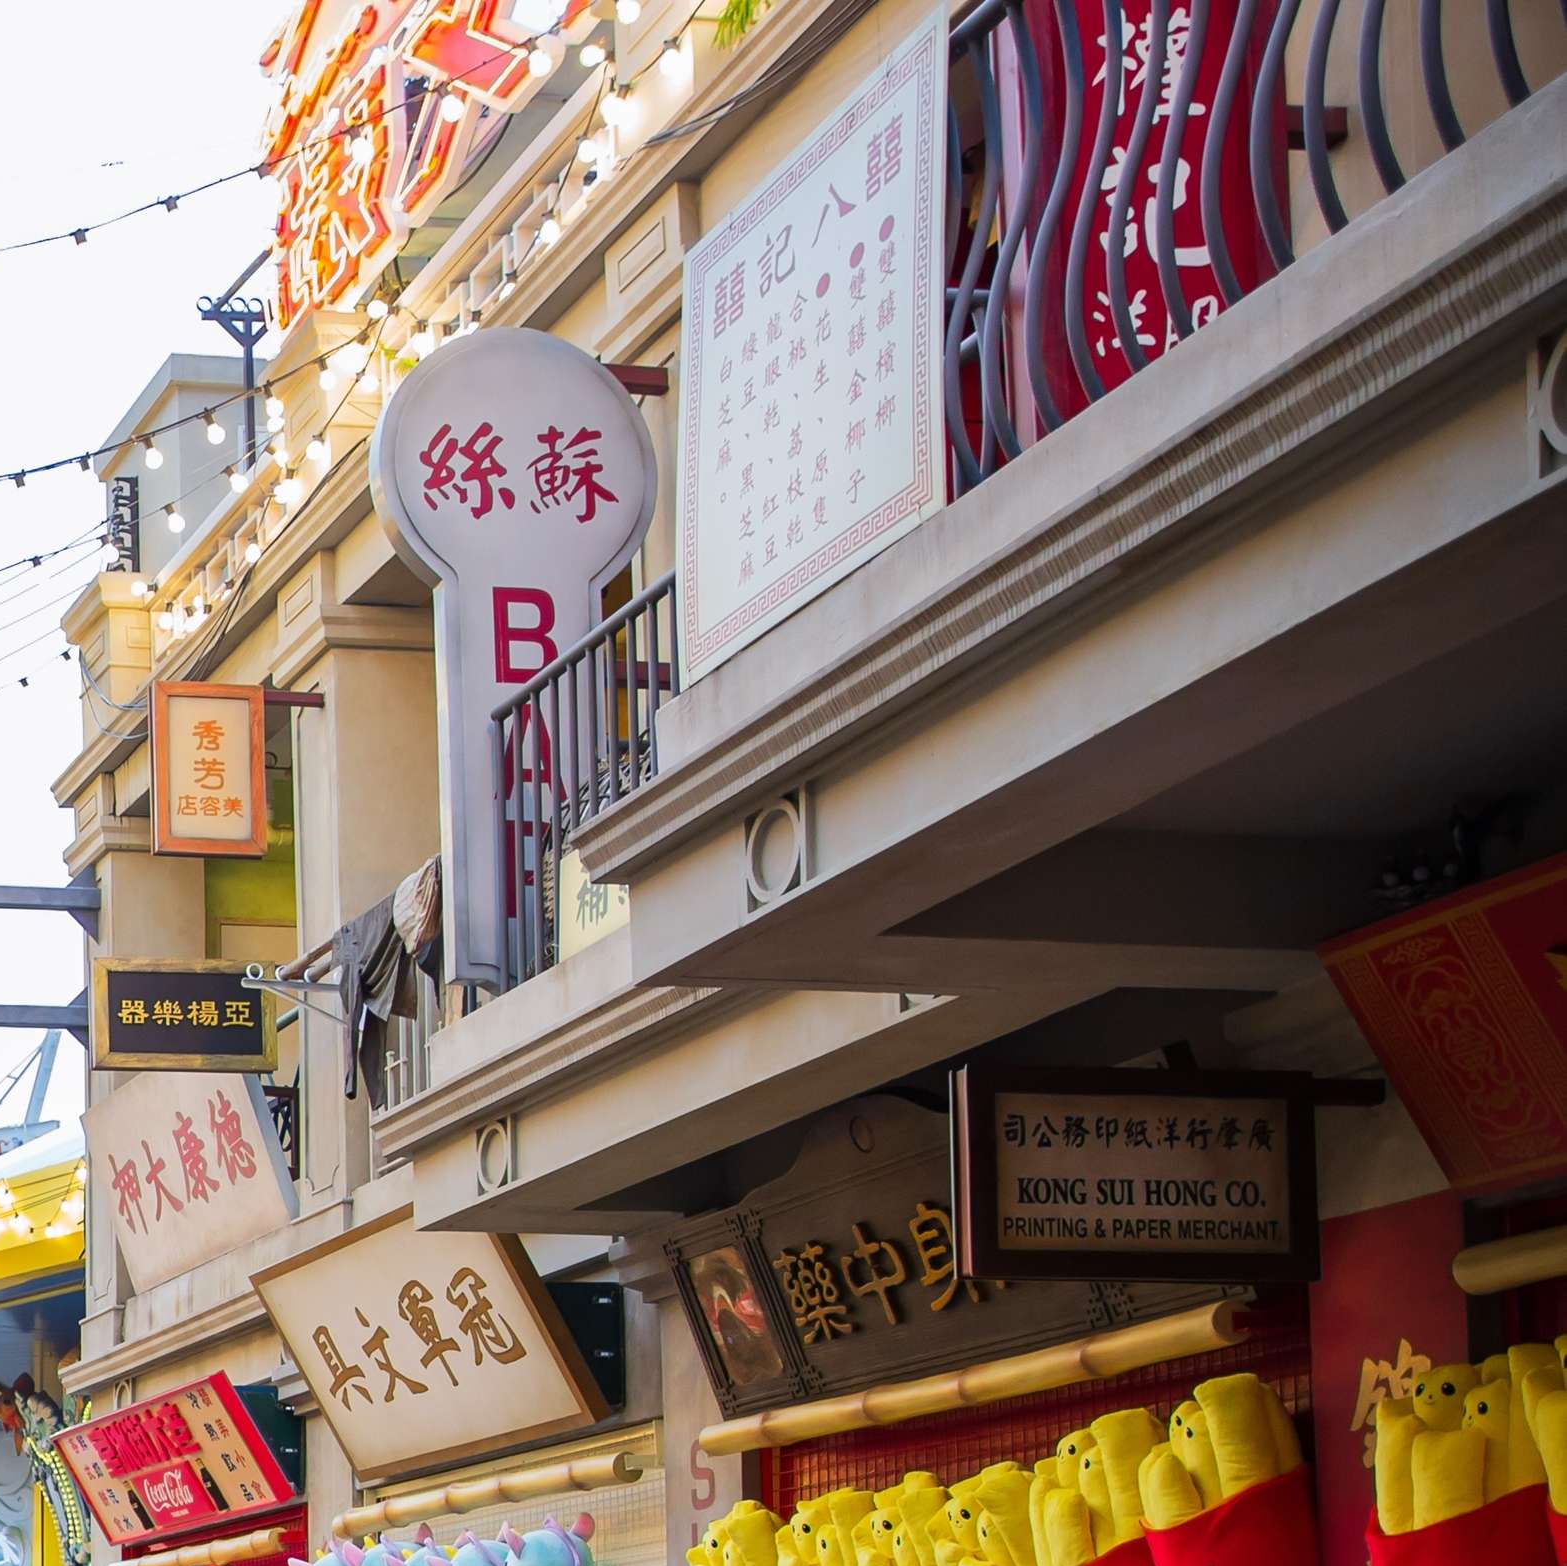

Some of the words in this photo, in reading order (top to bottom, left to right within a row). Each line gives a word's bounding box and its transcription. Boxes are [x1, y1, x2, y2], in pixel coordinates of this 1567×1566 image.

[193, 720, 227, 790] 秀芳
[1016, 1177, 1087, 1205] KONG
[1096, 1179, 1135, 1206] SUI
[1144, 1179, 1217, 1207] HONG
[1225, 1181, 1267, 1208] CO.
[1003, 1217, 1088, 1238] PRINTING
[1094, 1218, 1107, 1239] &
[1112, 1219, 1171, 1239] PAPER
